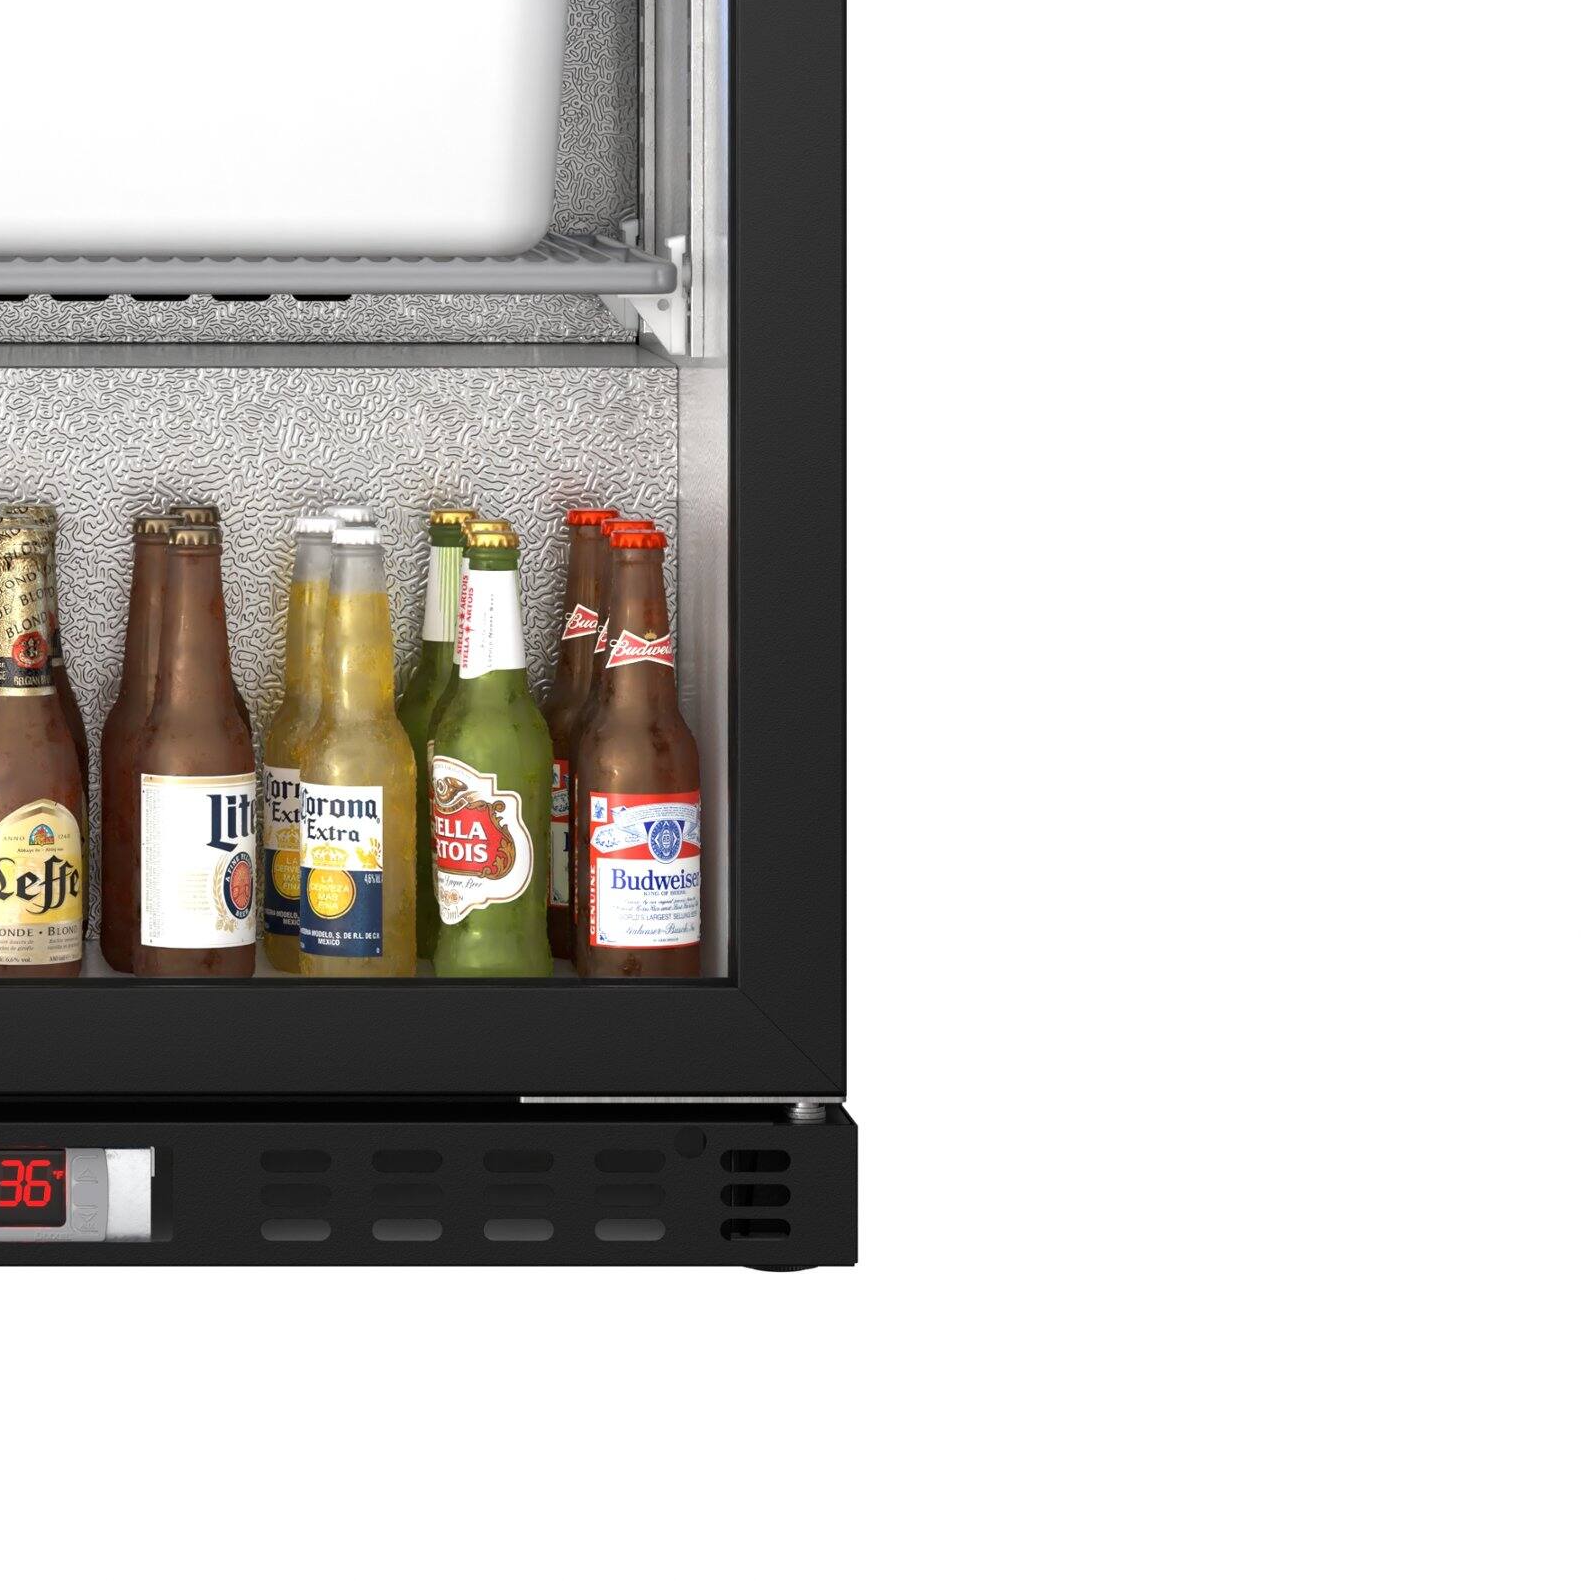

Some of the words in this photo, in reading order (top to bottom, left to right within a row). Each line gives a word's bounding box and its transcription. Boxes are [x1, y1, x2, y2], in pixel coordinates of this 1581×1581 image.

[460, 574, 469, 610] ARTOIS
[466, 587, 474, 622] ARTOIS
[272, 801, 300, 824] Ext
[301, 787, 378, 825] Corona
[307, 818, 360, 842] Extra
[436, 838, 488, 863] RTOIS
[227, 856, 240, 874] FINE
[647, 913, 672, 921] LARGEST
[318, 938, 340, 946] MEXICO
